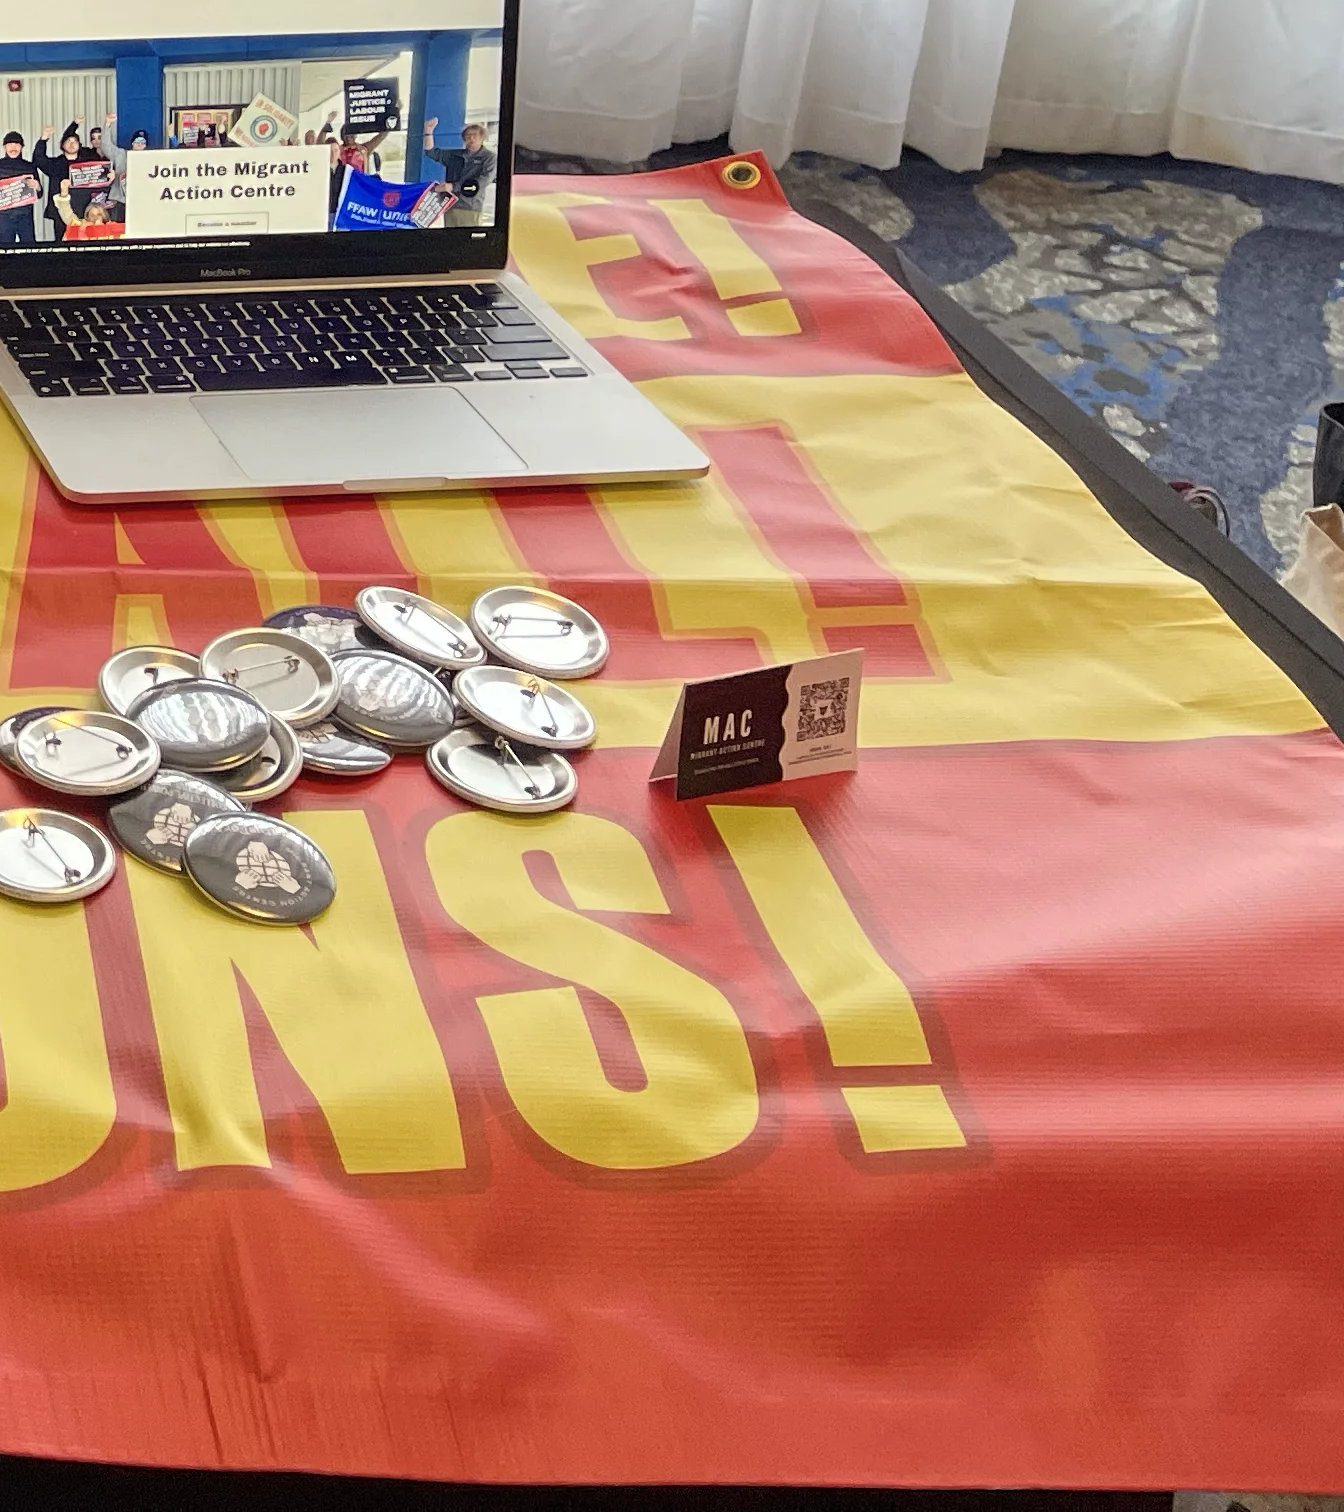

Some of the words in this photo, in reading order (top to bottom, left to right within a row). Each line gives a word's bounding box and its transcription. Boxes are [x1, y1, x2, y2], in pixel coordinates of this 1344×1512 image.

[149, 164, 188, 178] Join
[196, 163, 227, 176] the
[235, 161, 309, 178] Migrant
[160, 185, 223, 200] Action
[231, 184, 295, 198] Centre
[200, 269, 236, 278] MacBook
[238, 268, 251, 276] Pro
[704, 709, 753, 745] MAC
